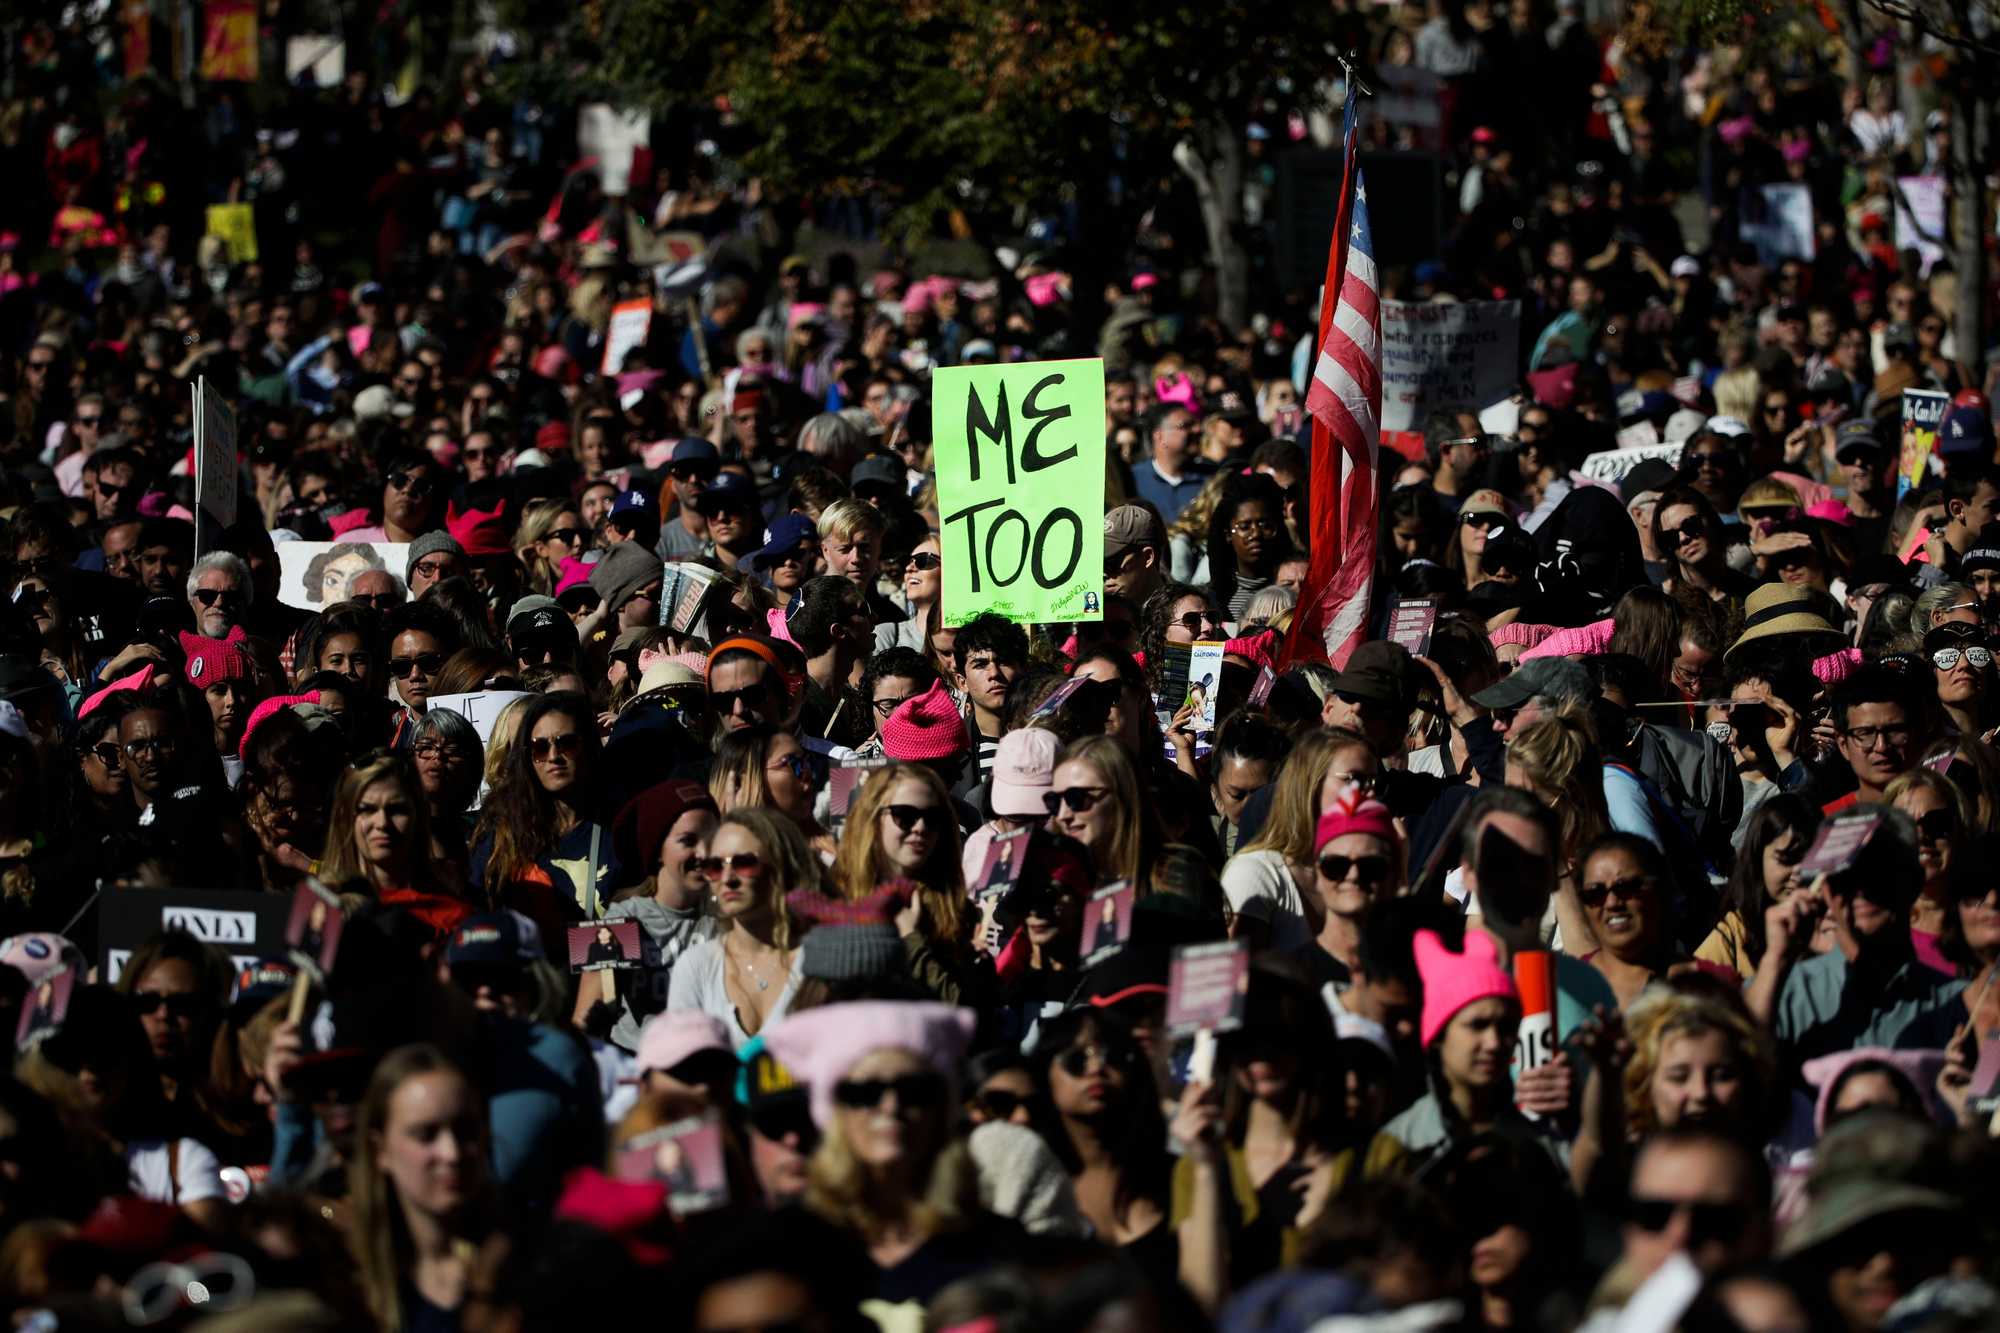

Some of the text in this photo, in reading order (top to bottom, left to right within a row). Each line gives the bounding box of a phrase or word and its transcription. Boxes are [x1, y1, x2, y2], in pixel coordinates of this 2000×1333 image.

[966, 373, 1078, 484] ME
[944, 497, 1083, 593] TOO
[1969, 653, 1989, 662] FACE
